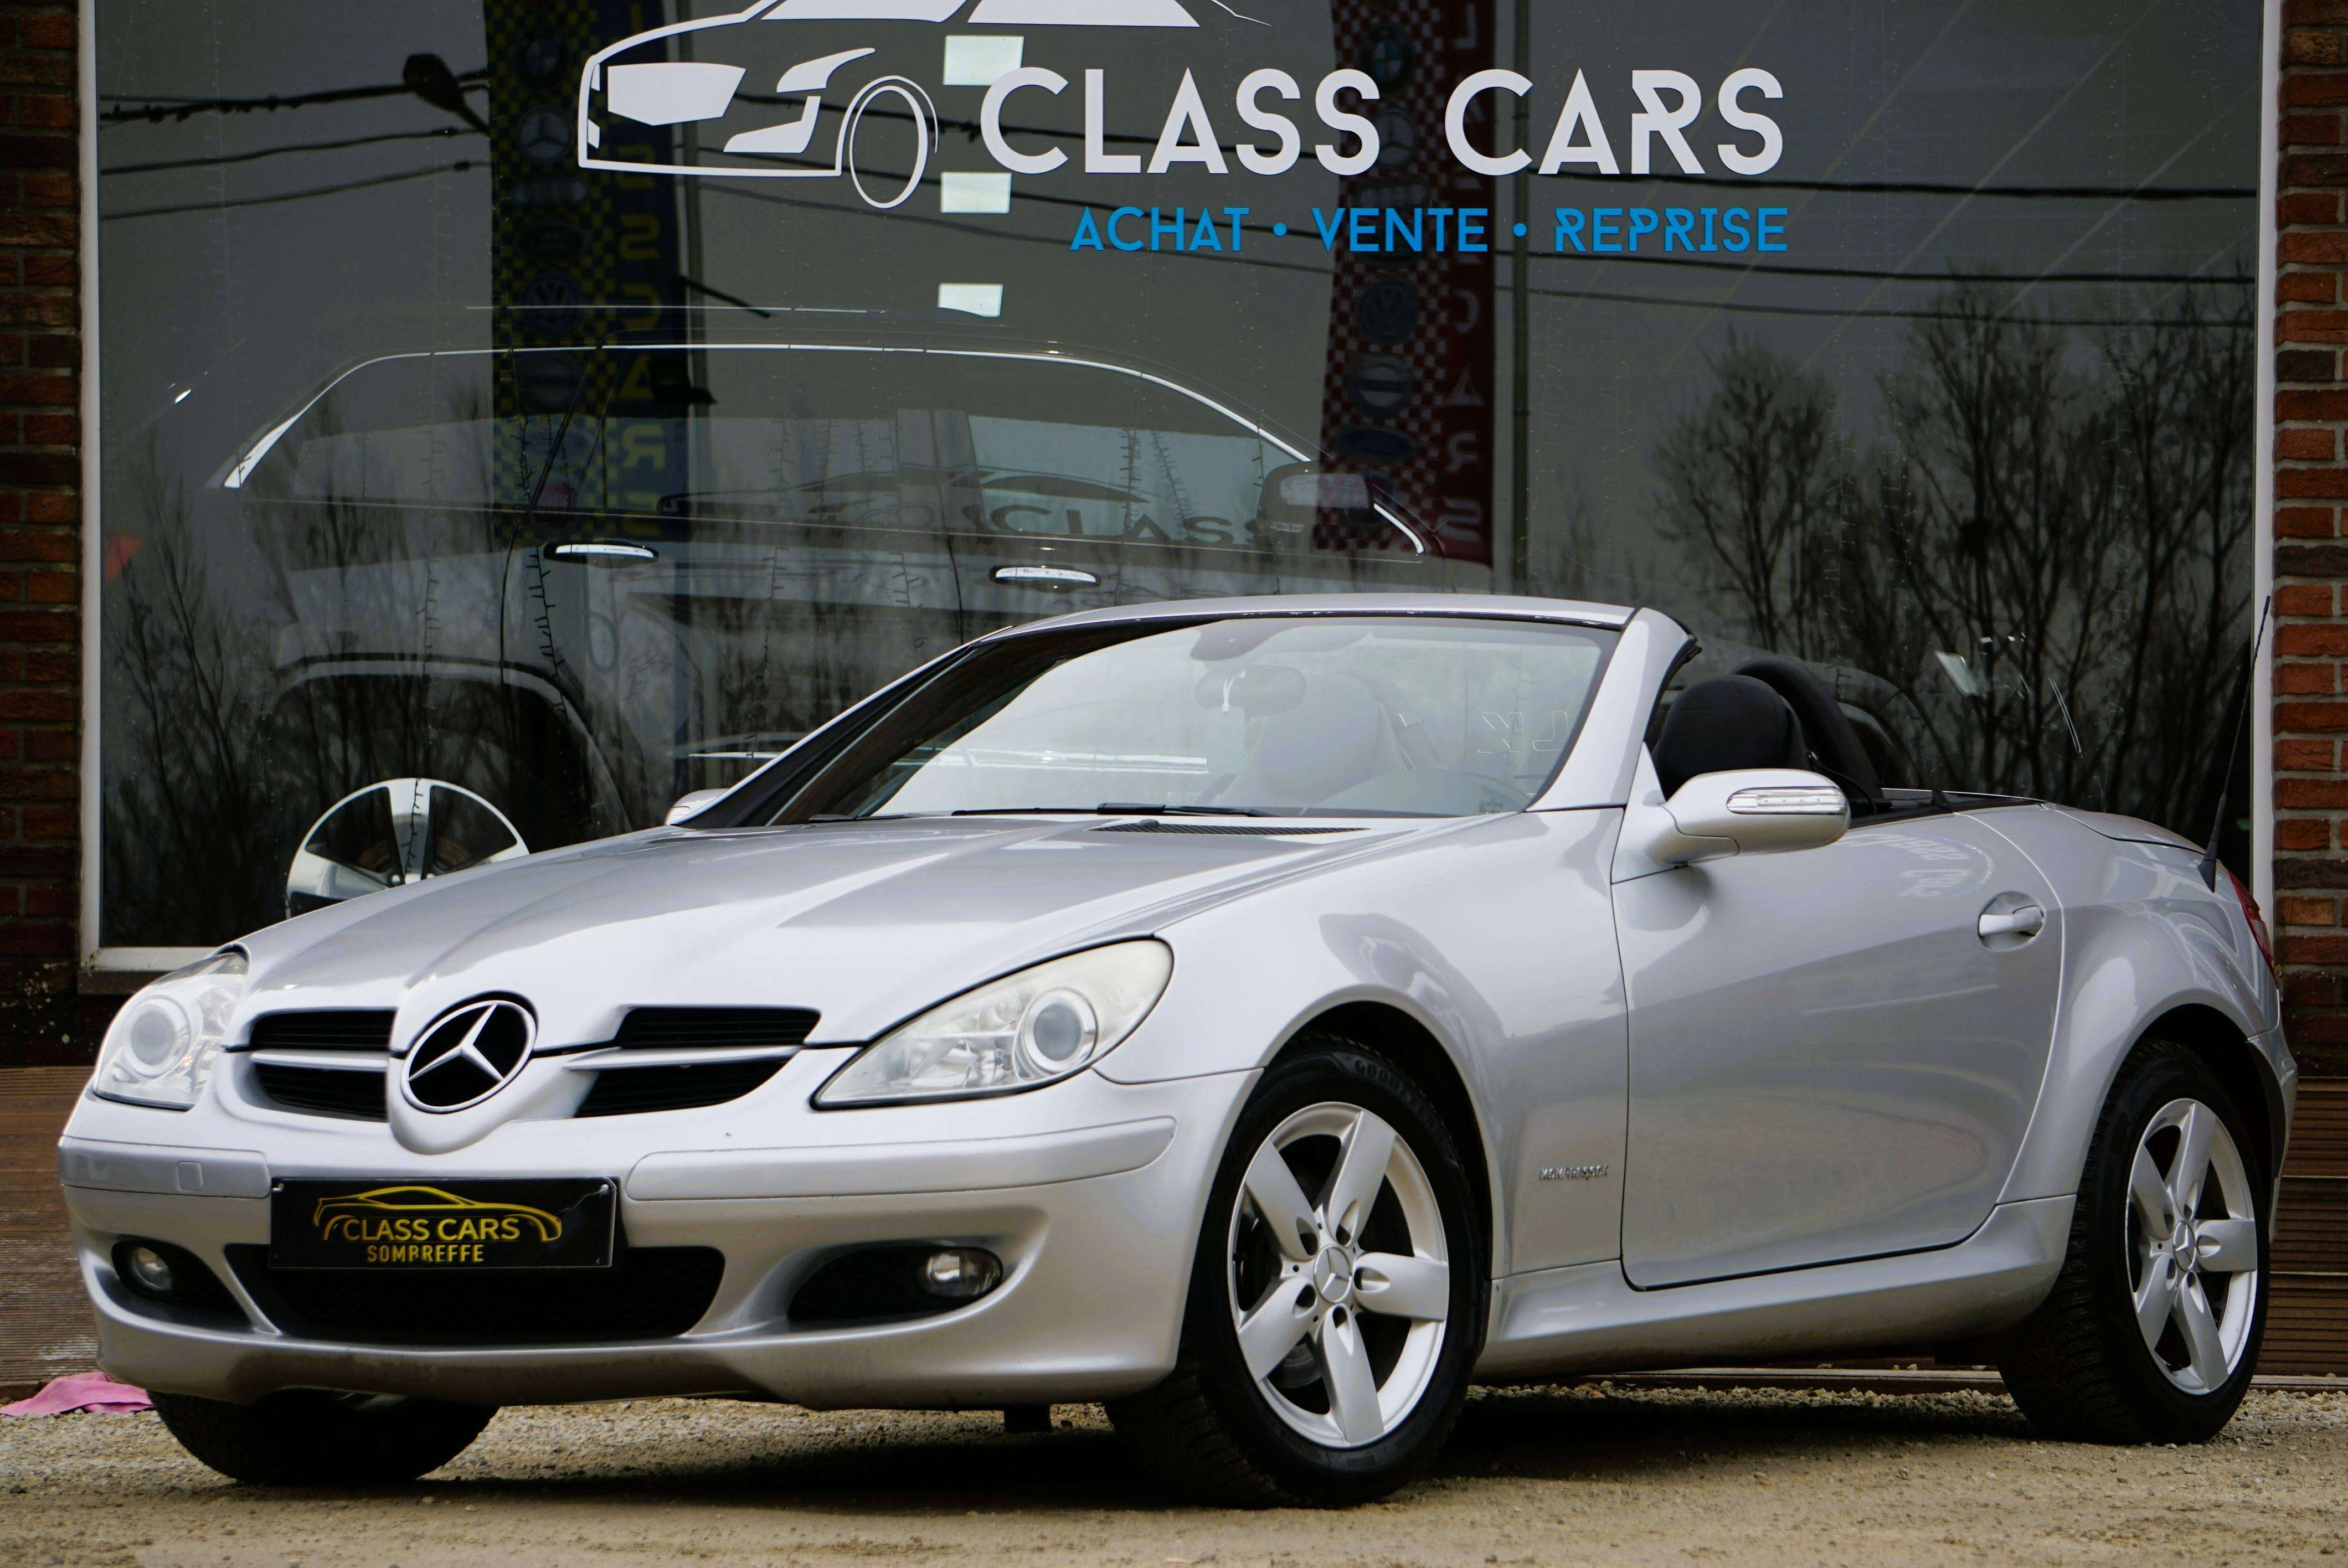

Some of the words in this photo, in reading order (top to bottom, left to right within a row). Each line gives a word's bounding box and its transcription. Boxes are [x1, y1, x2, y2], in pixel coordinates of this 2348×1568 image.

[980, 68, 1379, 175] CLASS
[1445, 68, 1783, 176] CARS
[1070, 206, 1250, 252] ACHAT
[1311, 207, 1489, 252] VENTE
[1554, 207, 1789, 252] REPRISE
[343, 1218, 430, 1241] CLASS
[436, 1218, 520, 1241] CARS
[367, 1244, 484, 1262] SOMBREFFE
